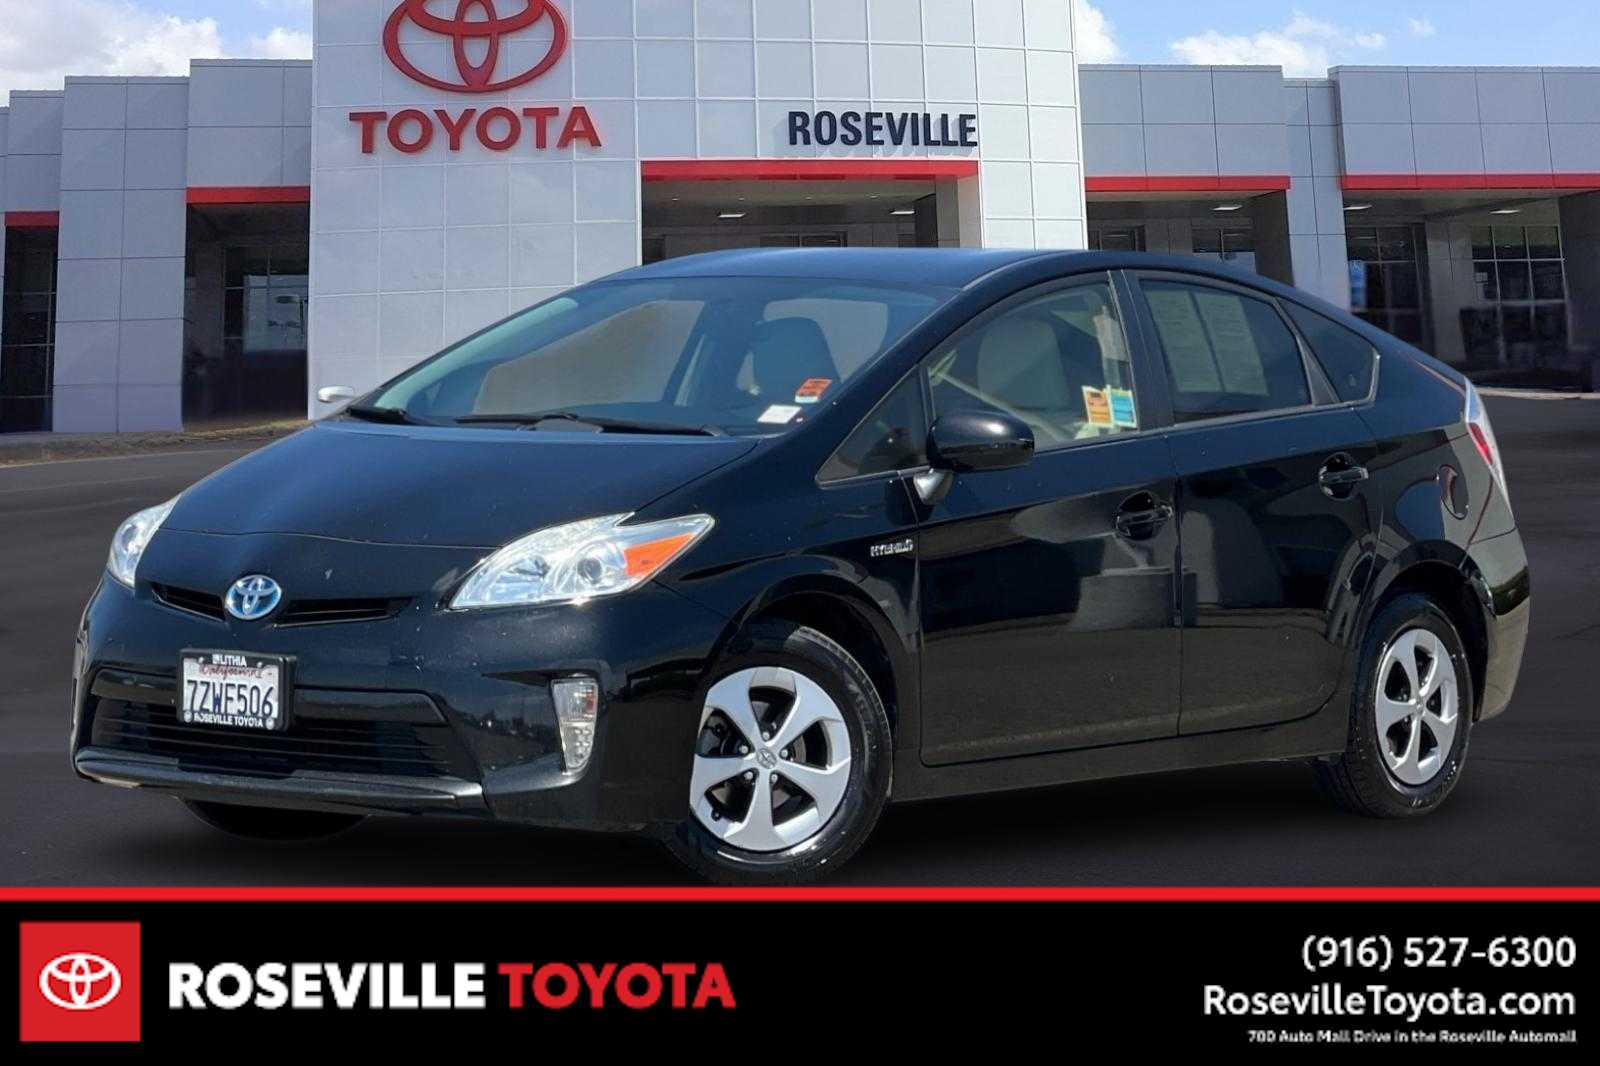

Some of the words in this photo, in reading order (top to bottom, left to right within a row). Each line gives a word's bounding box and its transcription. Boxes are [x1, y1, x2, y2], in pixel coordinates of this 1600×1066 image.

[349, 106, 603, 154] TOYOTA
[788, 110, 978, 147] ROSEVILLE
[187, 679, 274, 719] 7ZWF506
[194, 713, 233, 726] ROSEVILLE
[234, 716, 264, 728] TOYOTA
